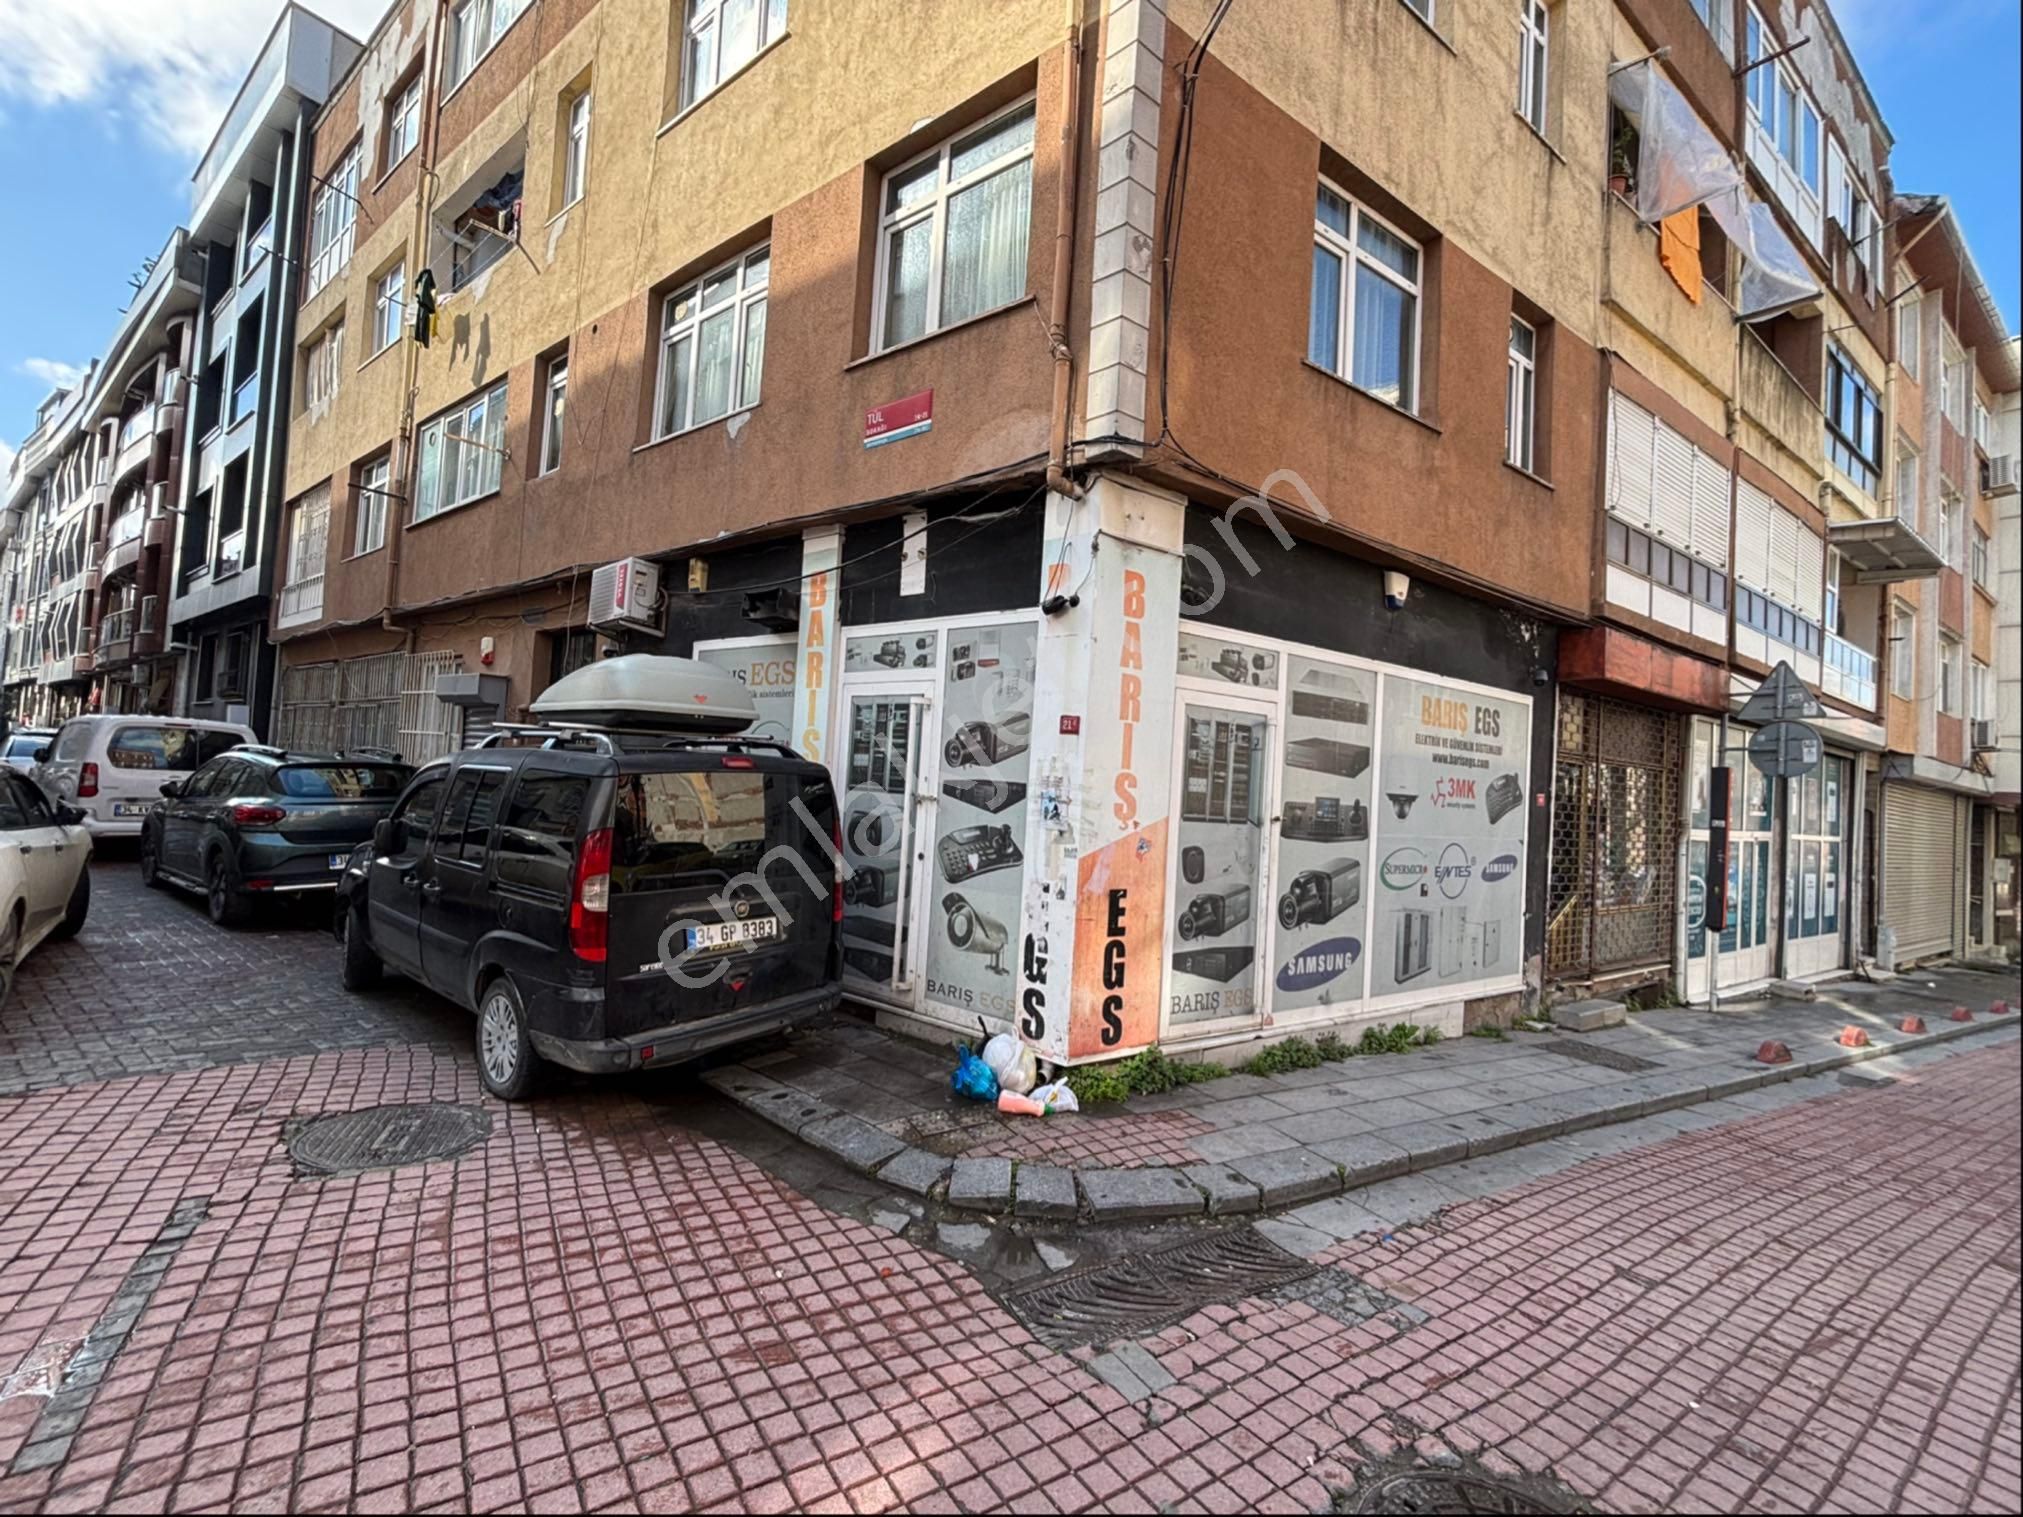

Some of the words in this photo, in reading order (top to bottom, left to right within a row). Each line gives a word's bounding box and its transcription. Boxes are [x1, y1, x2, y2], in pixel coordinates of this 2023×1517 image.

[751, 660, 796, 686] EGS
[1113, 568, 1146, 831] BARIŞ
[1422, 695, 1468, 737] BARIŞ
[1474, 705, 1501, 738] EGS
[1432, 753, 1489, 769] www.barisegs.com
[1447, 778, 1476, 800] 3MK
[697, 927, 714, 946] 34
[720, 924, 737, 941] GP
[742, 919, 774, 938] 8383
[1022, 883, 1049, 1041] GS
[1101, 889, 1127, 1046] EGS
[1287, 951, 1353, 976] SAMSUNG
[927, 980, 974, 1007] BARIŞ
[1171, 991, 1220, 1015] BARIŞ
[1223, 987, 1255, 1009] EGS
